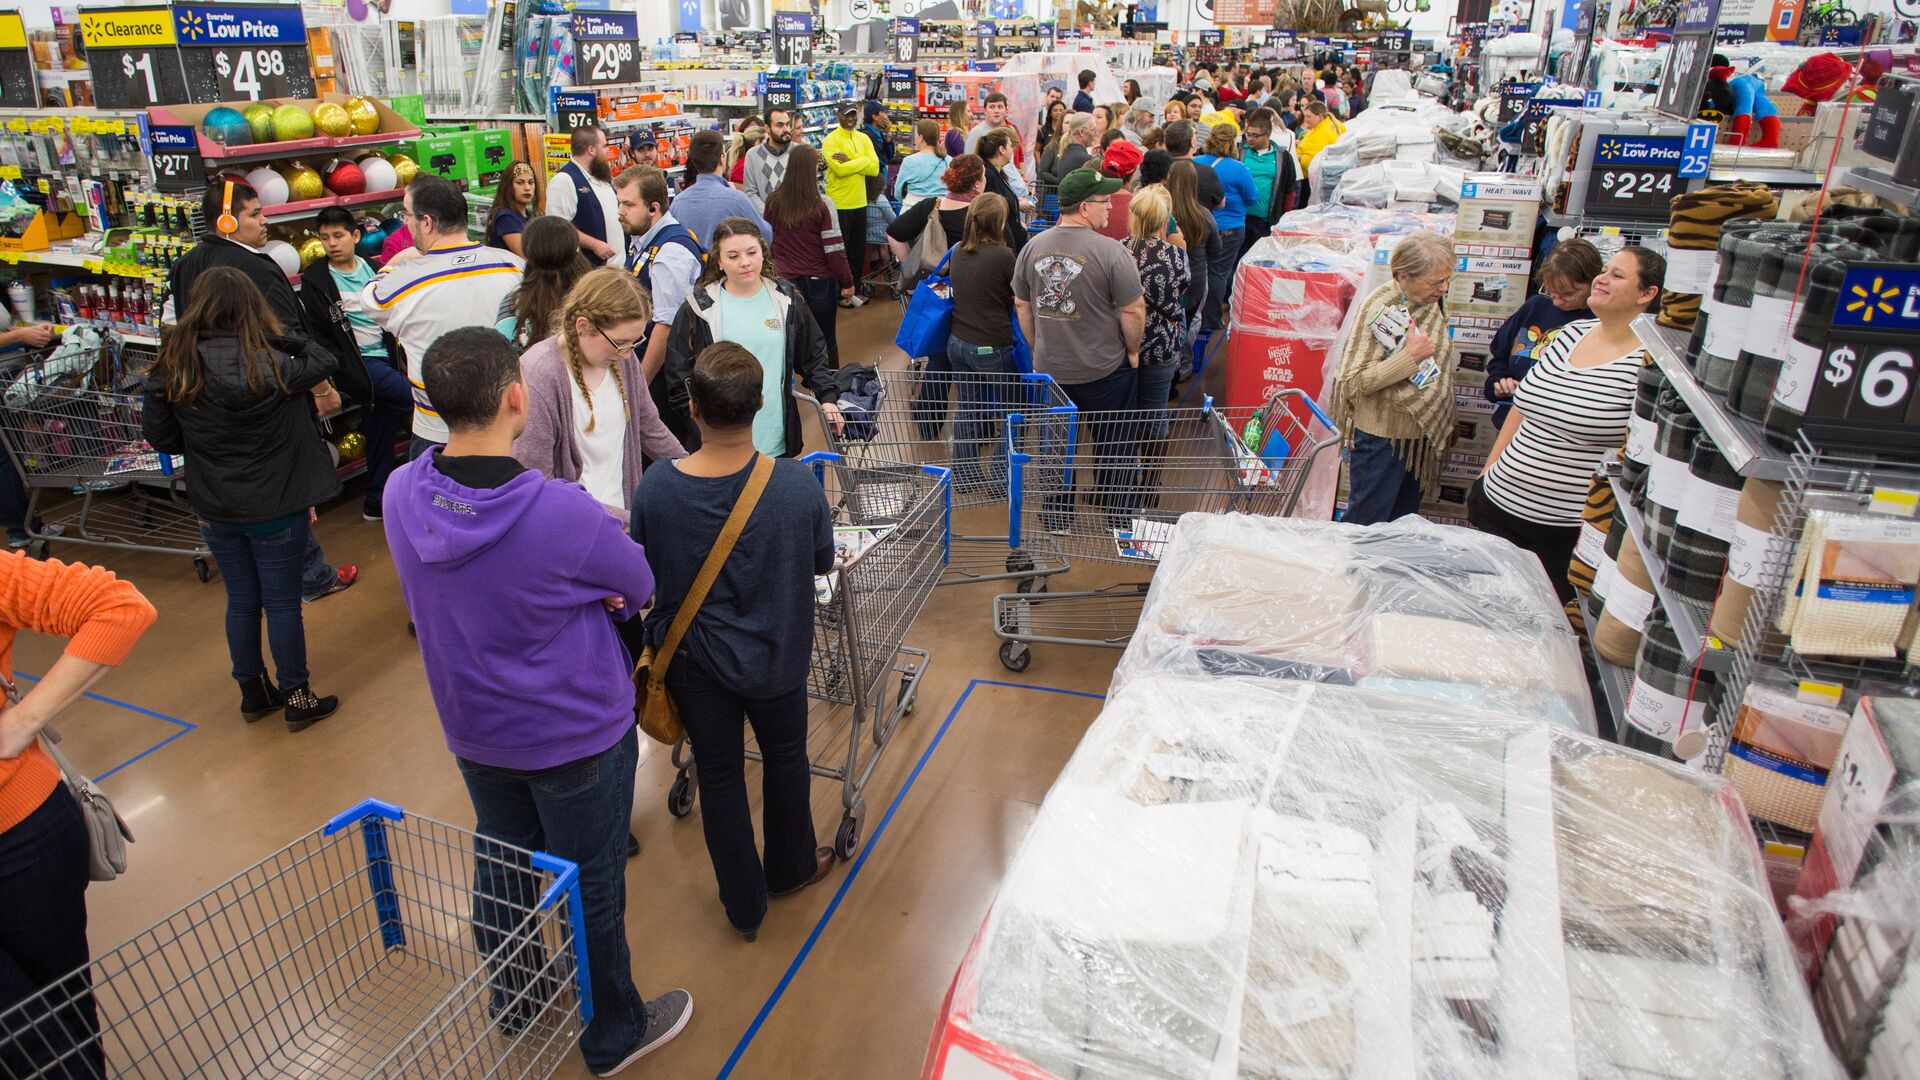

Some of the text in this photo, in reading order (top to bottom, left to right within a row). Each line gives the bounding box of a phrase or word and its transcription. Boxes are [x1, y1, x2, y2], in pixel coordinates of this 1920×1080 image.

[206, 13, 234, 22] Everyday
[104, 21, 163, 37] Clearance
[207, 20, 279, 38] Low Price
[587, 22, 624, 36] Low Price
[1727, 28, 1745, 36] Price
[122, 52, 158, 103] $1
[1586, 93, 1598, 108] H
[155, 134, 187, 144] Low Price
[1690, 127, 1711, 149] H
[1622, 147, 1681, 159] Low Price
[1681, 155, 1708, 174] 25
[1512, 188, 1533, 196] WAVE
[1475, 260, 1522, 270] HEAT WAVE
[1267, 346, 1293, 360] INSIDE
[1274, 356, 1291, 366] OUT
[1263, 371, 1294, 383] WARS
[1266, 366, 1292, 376] STAR
[1823, 346, 1914, 407] $6
[1456, 400, 1496, 411] EAT WAVE
[1466, 467, 1481, 476] WAV
